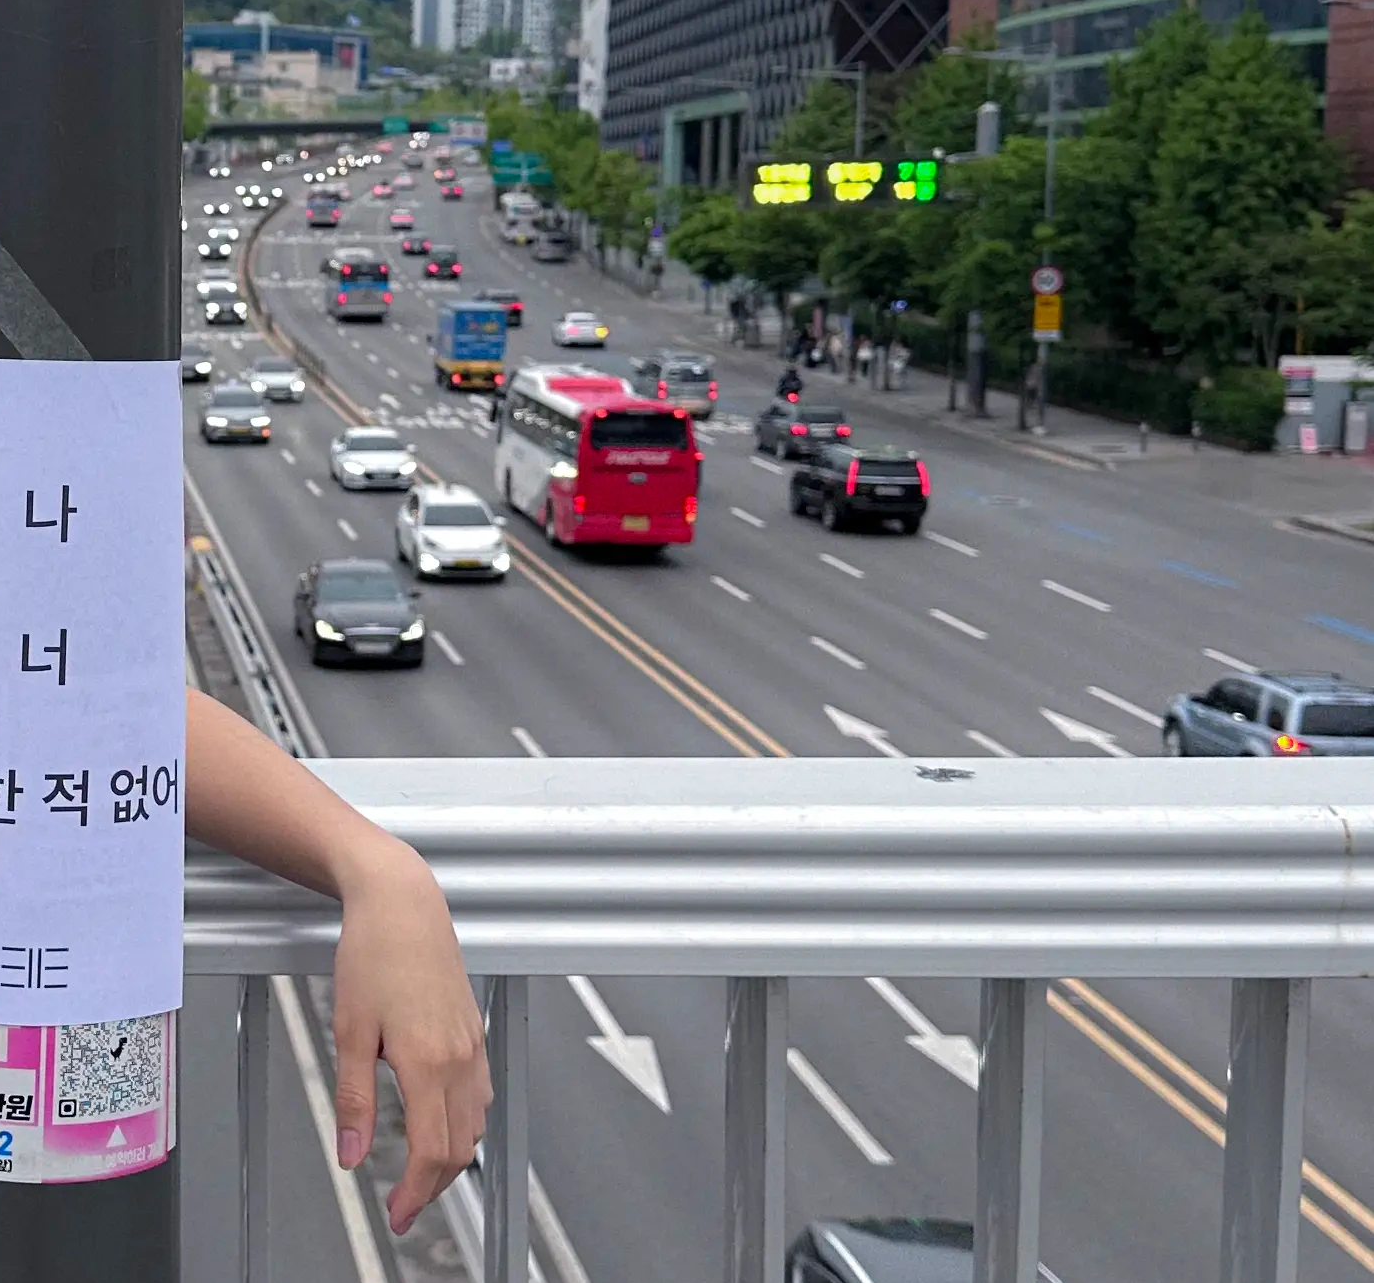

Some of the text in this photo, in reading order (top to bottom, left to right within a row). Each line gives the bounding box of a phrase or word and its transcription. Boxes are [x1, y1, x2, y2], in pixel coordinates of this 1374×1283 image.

[26, 485, 77, 542] 나
[22, 629, 67, 685] 너
[42, 770, 89, 826] 적
[110, 758, 178, 823] 없어
